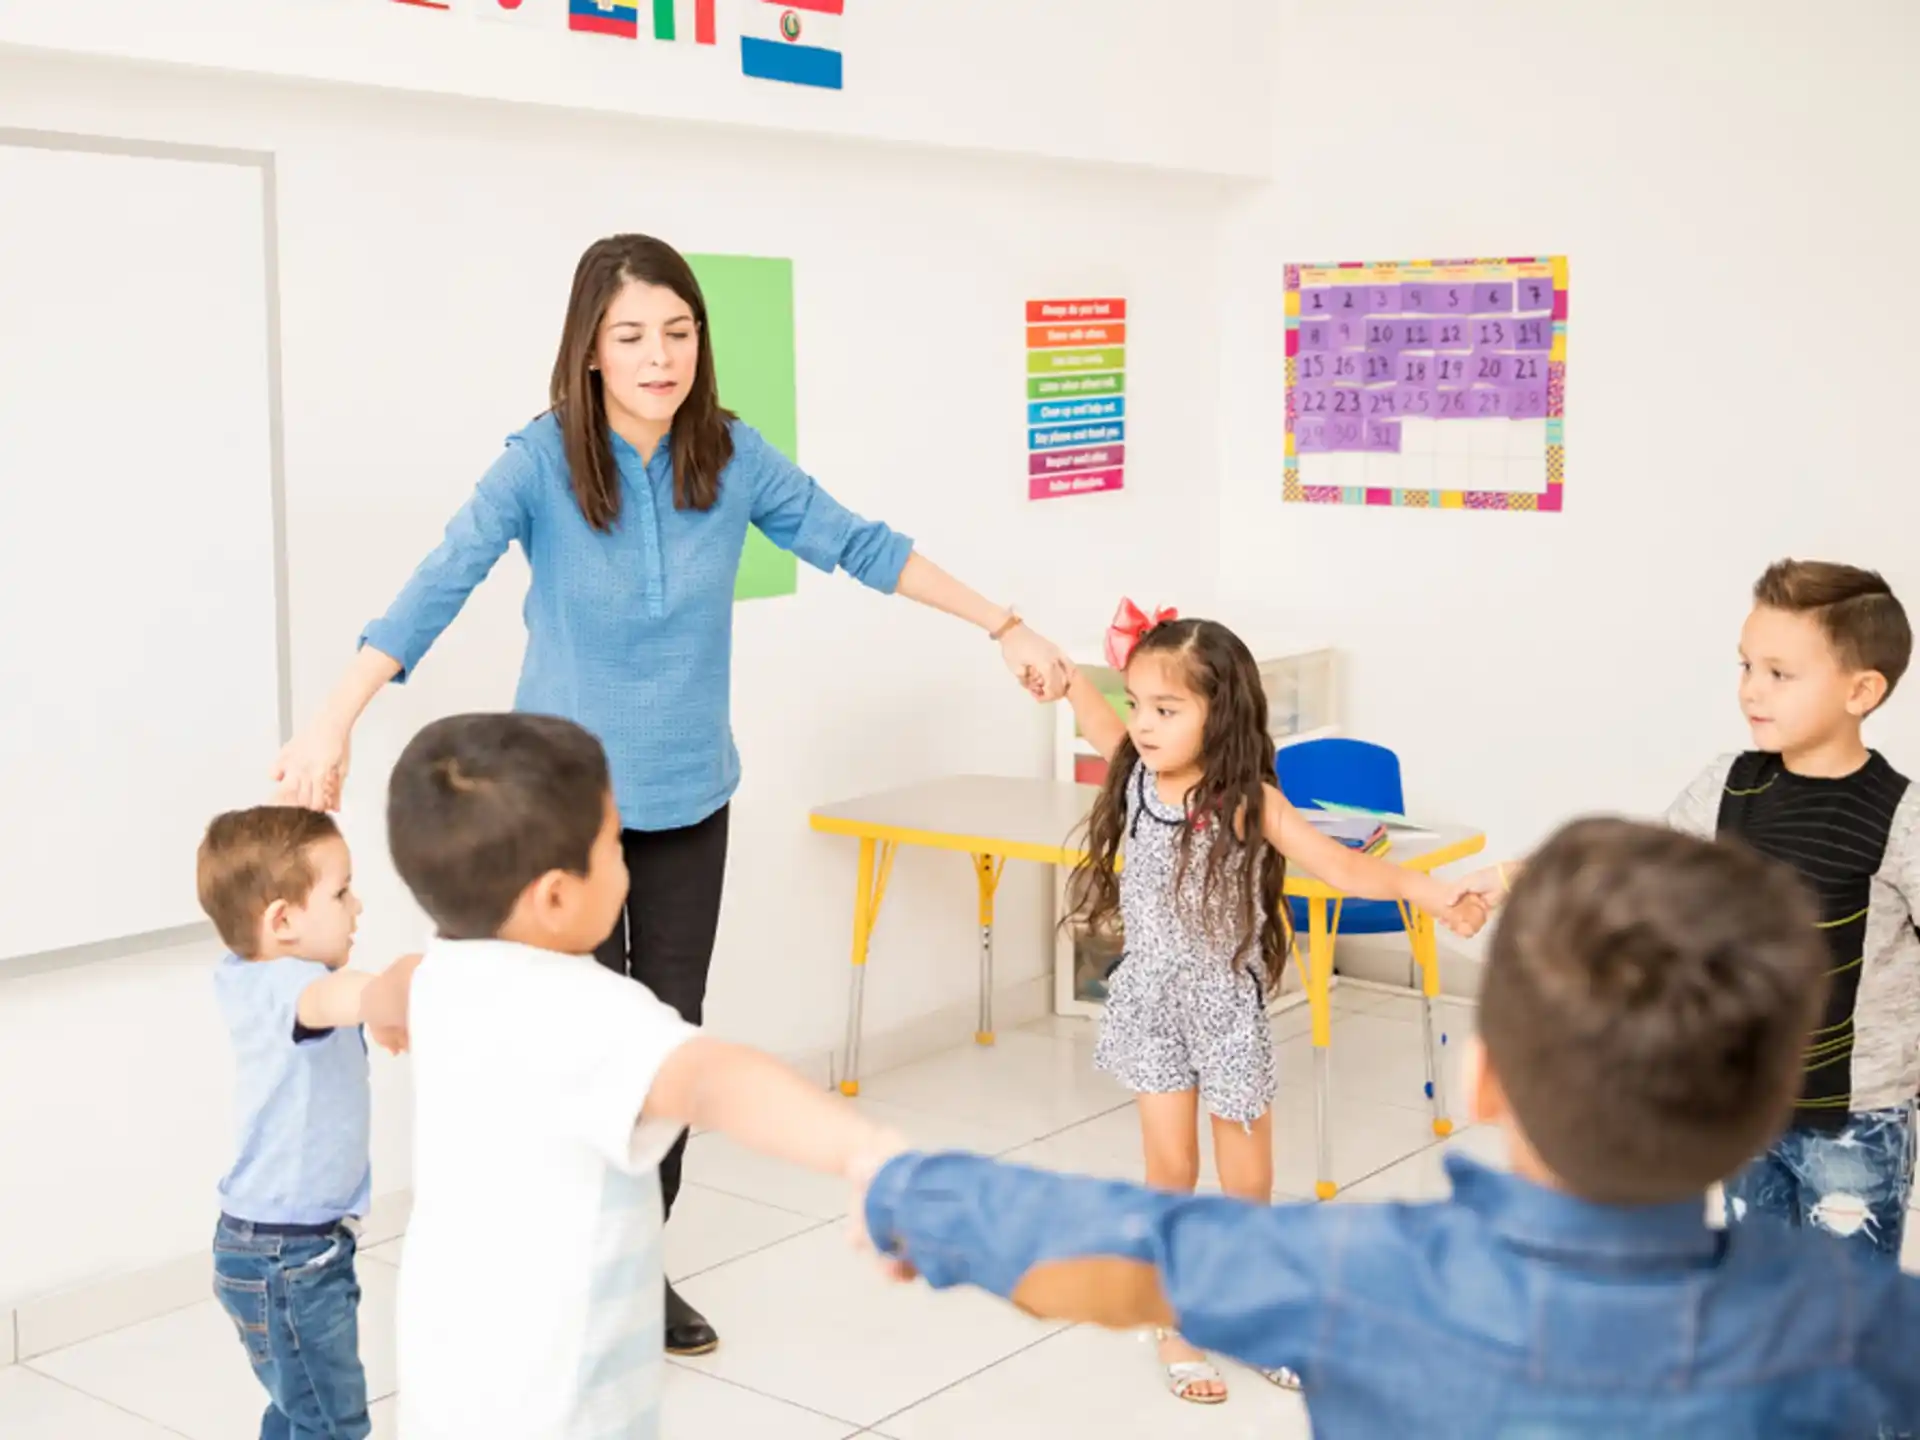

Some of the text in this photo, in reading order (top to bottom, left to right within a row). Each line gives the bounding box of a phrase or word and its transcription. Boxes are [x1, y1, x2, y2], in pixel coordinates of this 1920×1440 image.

[1312, 292, 1323, 309] 1
[1343, 291, 1355, 308] 2
[1377, 290, 1388, 307] 3
[1447, 289, 1459, 307] 5
[1488, 290, 1499, 305] 6
[1528, 286, 1542, 304] 7
[1309, 322, 1542, 345] 8 9 10 11 12 13 14
[1301, 356, 1538, 382] 15 16 17 18 19 20 21
[1301, 390, 1541, 414] 22 23 24 25 26 27 28
[1300, 424, 1392, 447] 29 30 31
